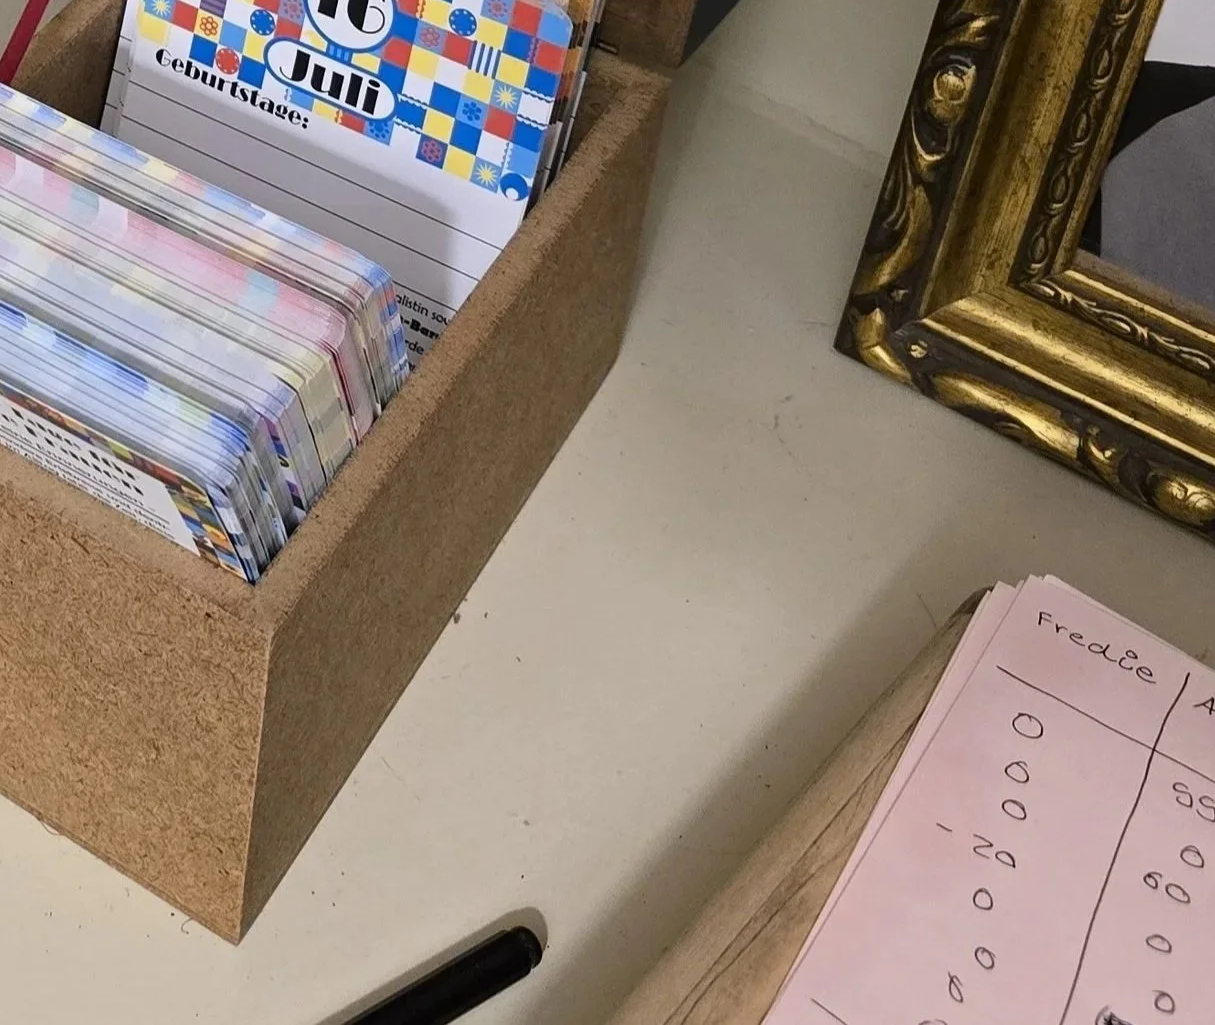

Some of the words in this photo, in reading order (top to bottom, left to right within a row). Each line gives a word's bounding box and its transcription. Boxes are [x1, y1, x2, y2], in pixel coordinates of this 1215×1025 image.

[155, 48, 309, 130] Geburtstage:
[279, 49, 381, 115] Juli
[1037, 611, 1157, 685] Fredie
[972, 887, 994, 911] 0
